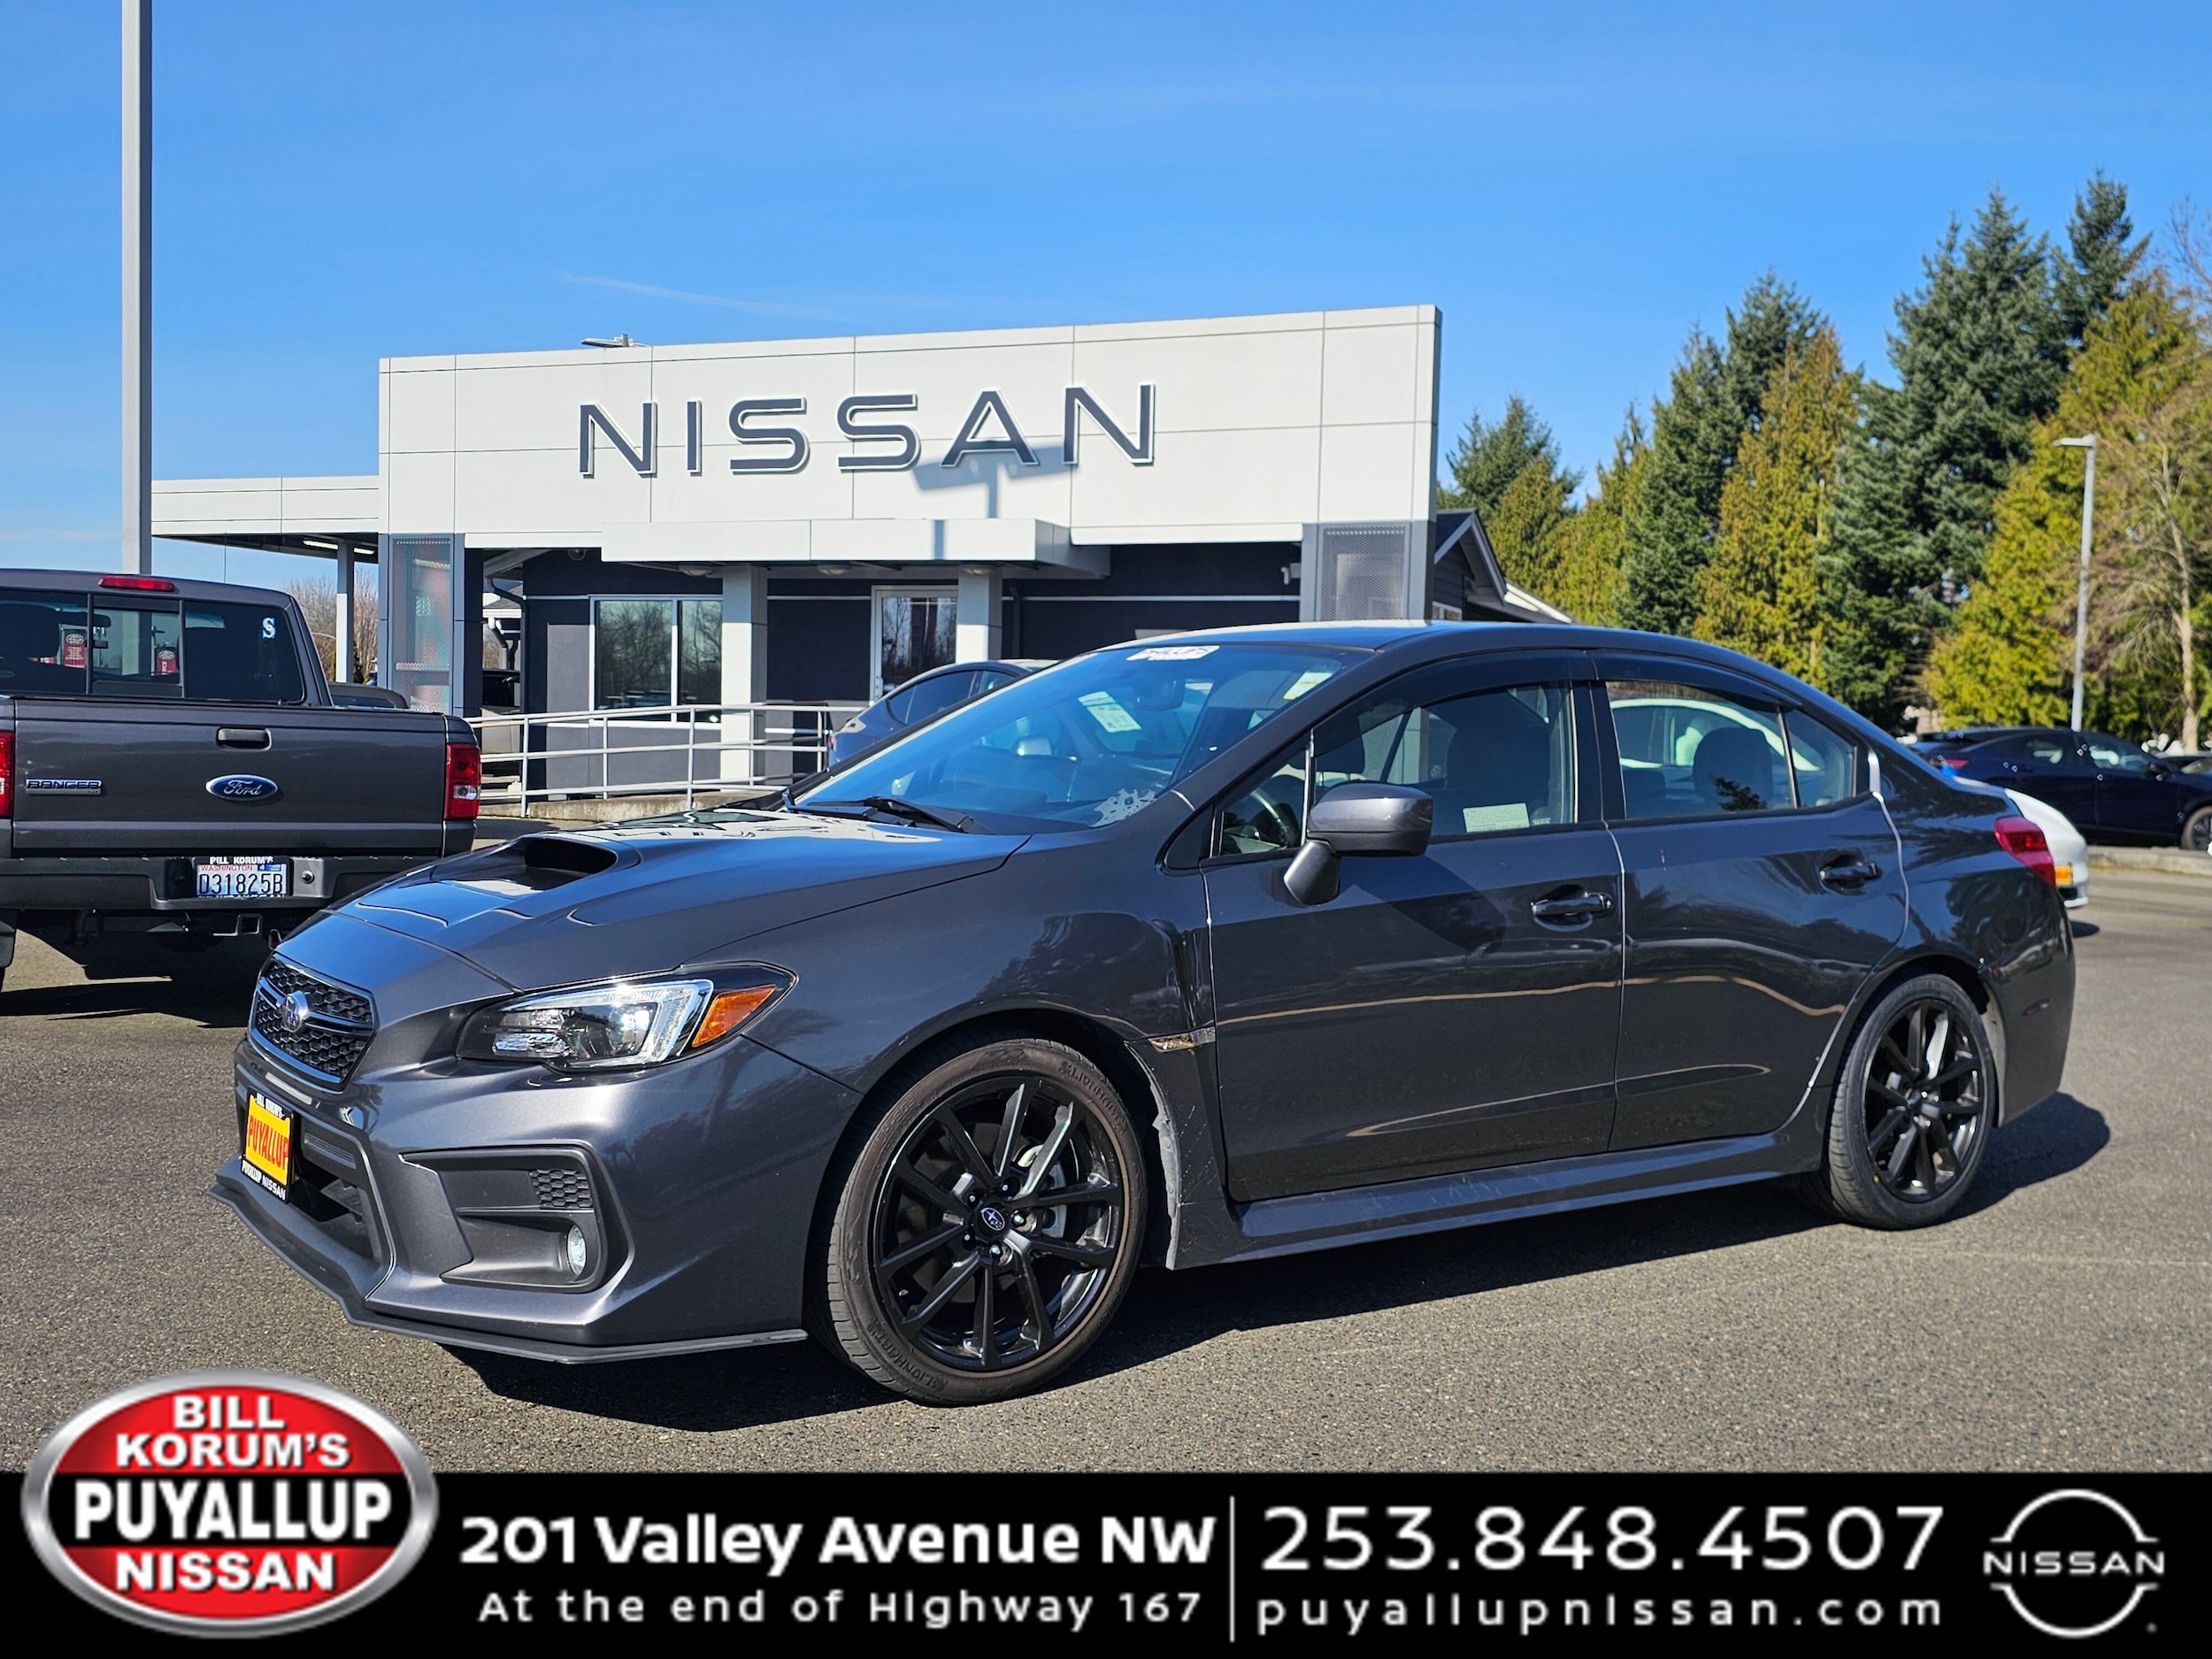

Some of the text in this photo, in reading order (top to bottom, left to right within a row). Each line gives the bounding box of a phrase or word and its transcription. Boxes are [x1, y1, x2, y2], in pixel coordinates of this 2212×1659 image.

[579, 384, 1155, 477] NISSAN
[27, 780, 100, 789] RANGER
[223, 780, 263, 796] Ford
[199, 873, 283, 895] D31825B
[249, 1115, 290, 1171] PUYALLUP
[262, 1174, 287, 1201] NISSAN
